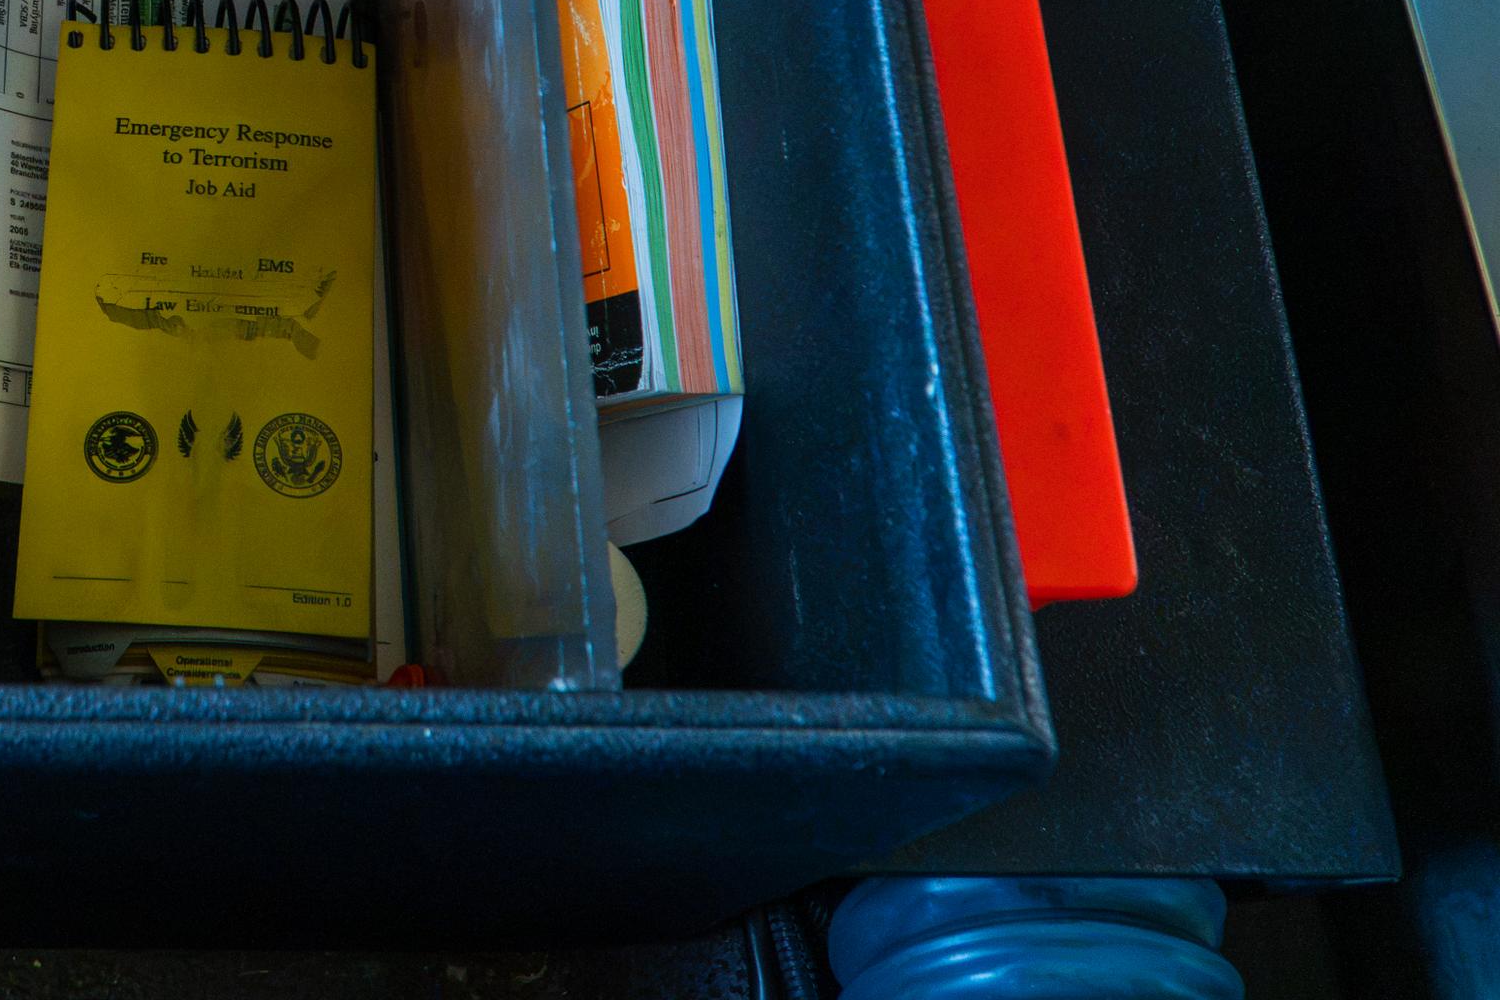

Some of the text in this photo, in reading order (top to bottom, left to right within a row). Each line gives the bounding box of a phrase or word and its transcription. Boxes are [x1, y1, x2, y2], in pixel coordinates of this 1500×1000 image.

[20, 4, 29, 28] SCBA
[115, 118, 333, 149] Emergency Response
[163, 148, 289, 171] to Terrorism
[186, 179, 256, 198] Job Aid
[141, 252, 168, 265] Fire
[258, 258, 294, 273] EMS
[145, 297, 177, 311] Law
[292, 594, 352, 607] Edition 1.0
[175, 655, 233, 667] Operational
